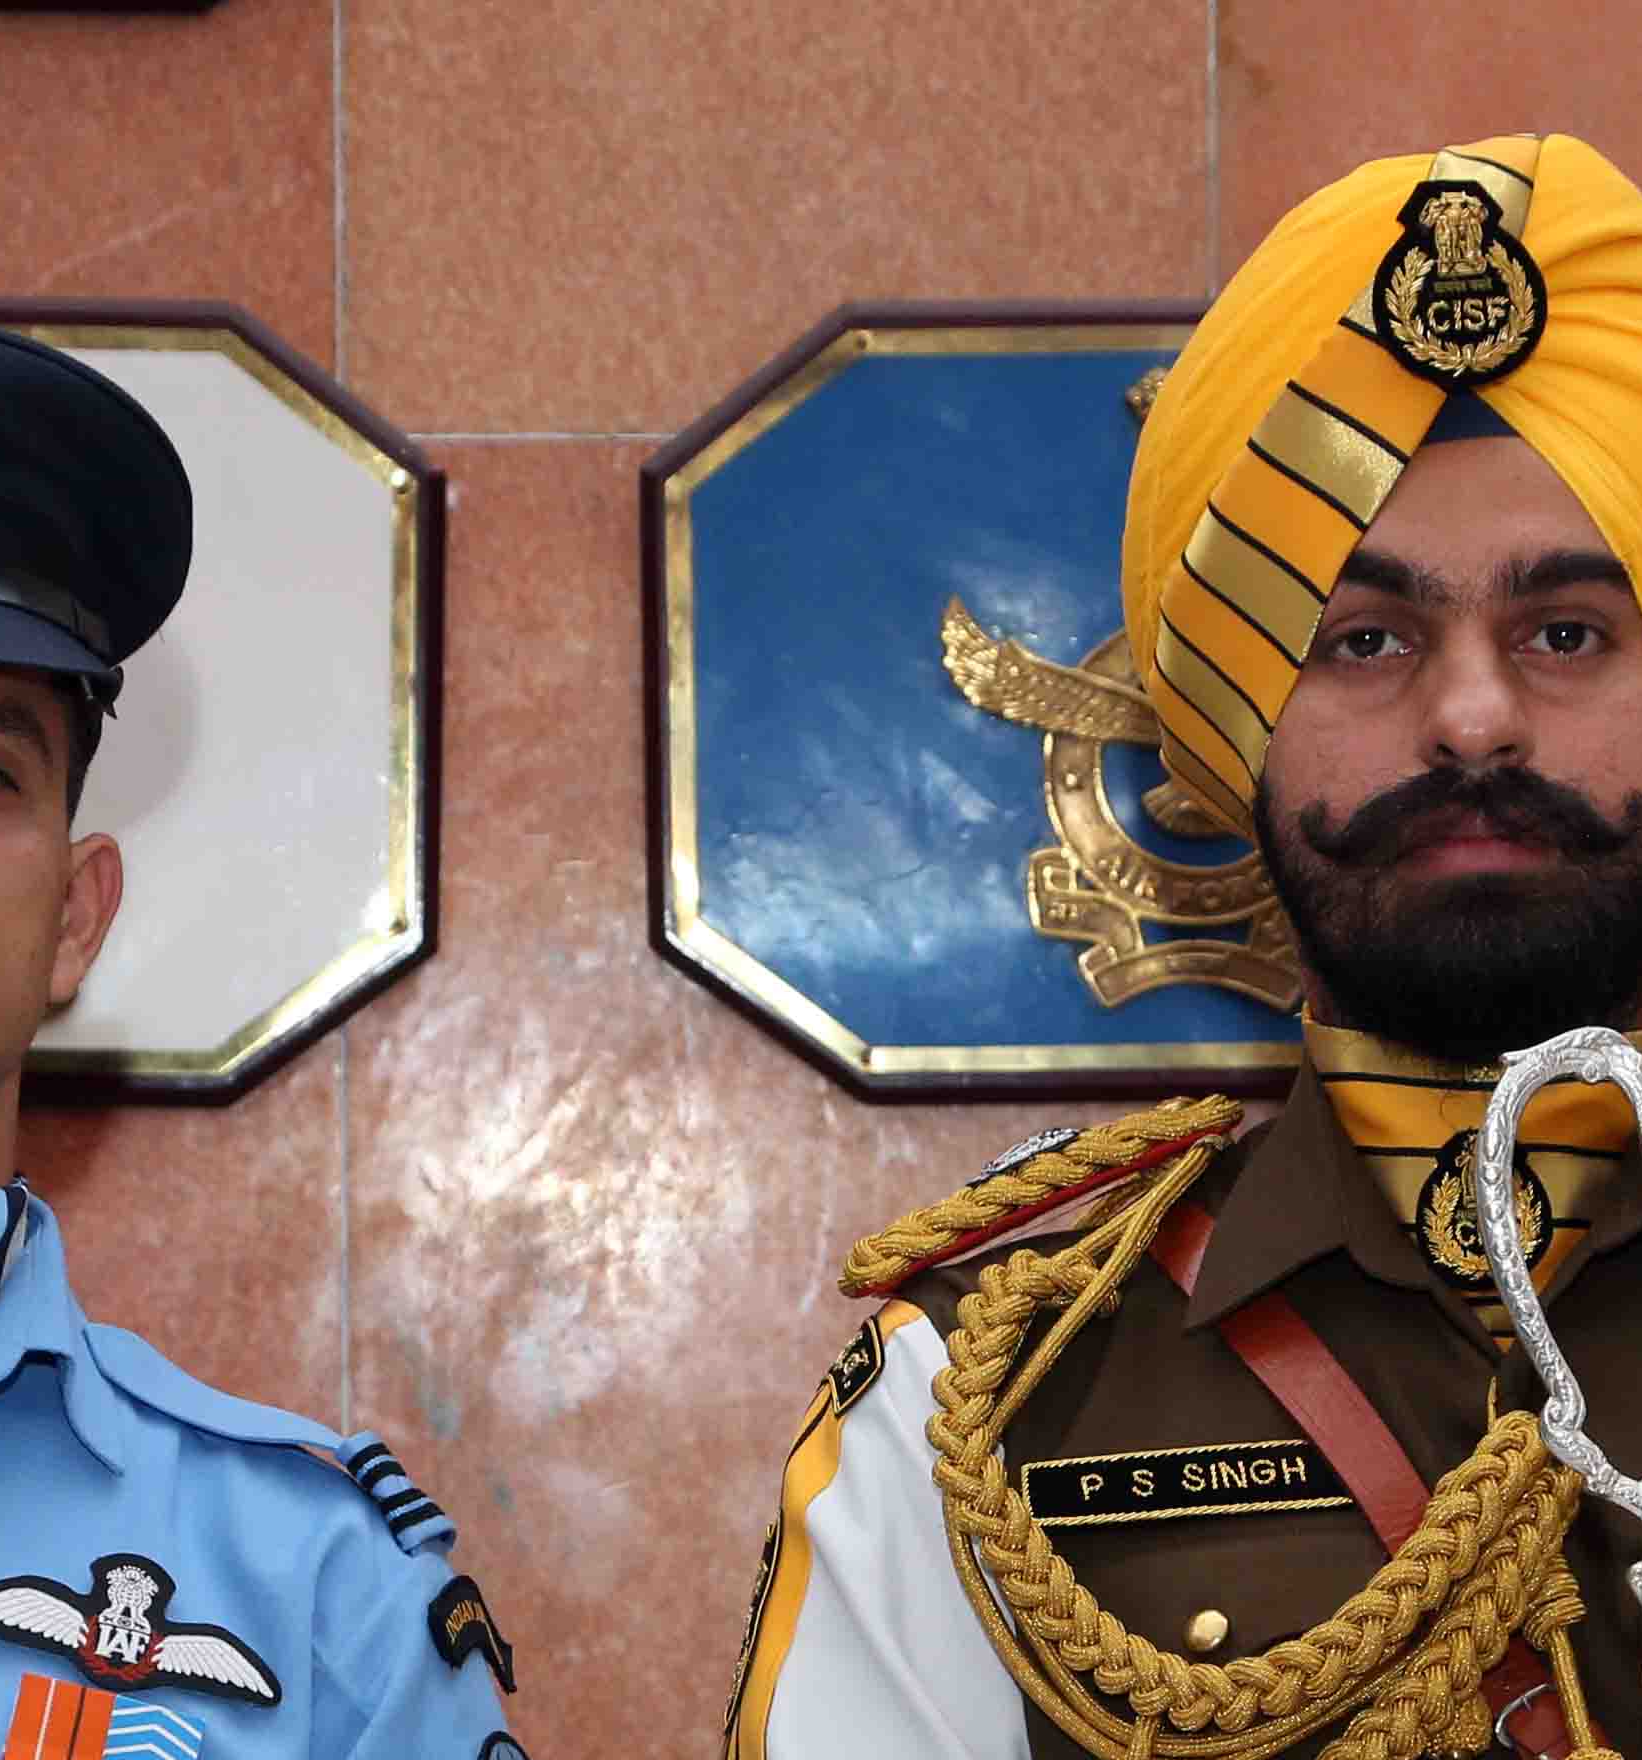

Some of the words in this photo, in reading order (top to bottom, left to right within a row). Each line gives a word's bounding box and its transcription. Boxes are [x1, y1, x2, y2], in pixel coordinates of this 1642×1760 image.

[1428, 296, 1510, 332] CISF
[1080, 1474, 1104, 1501] P
[1131, 1469, 1156, 1498] S
[1181, 1456, 1308, 1493] SINGH
[94, 1623, 151, 1664] IAF
